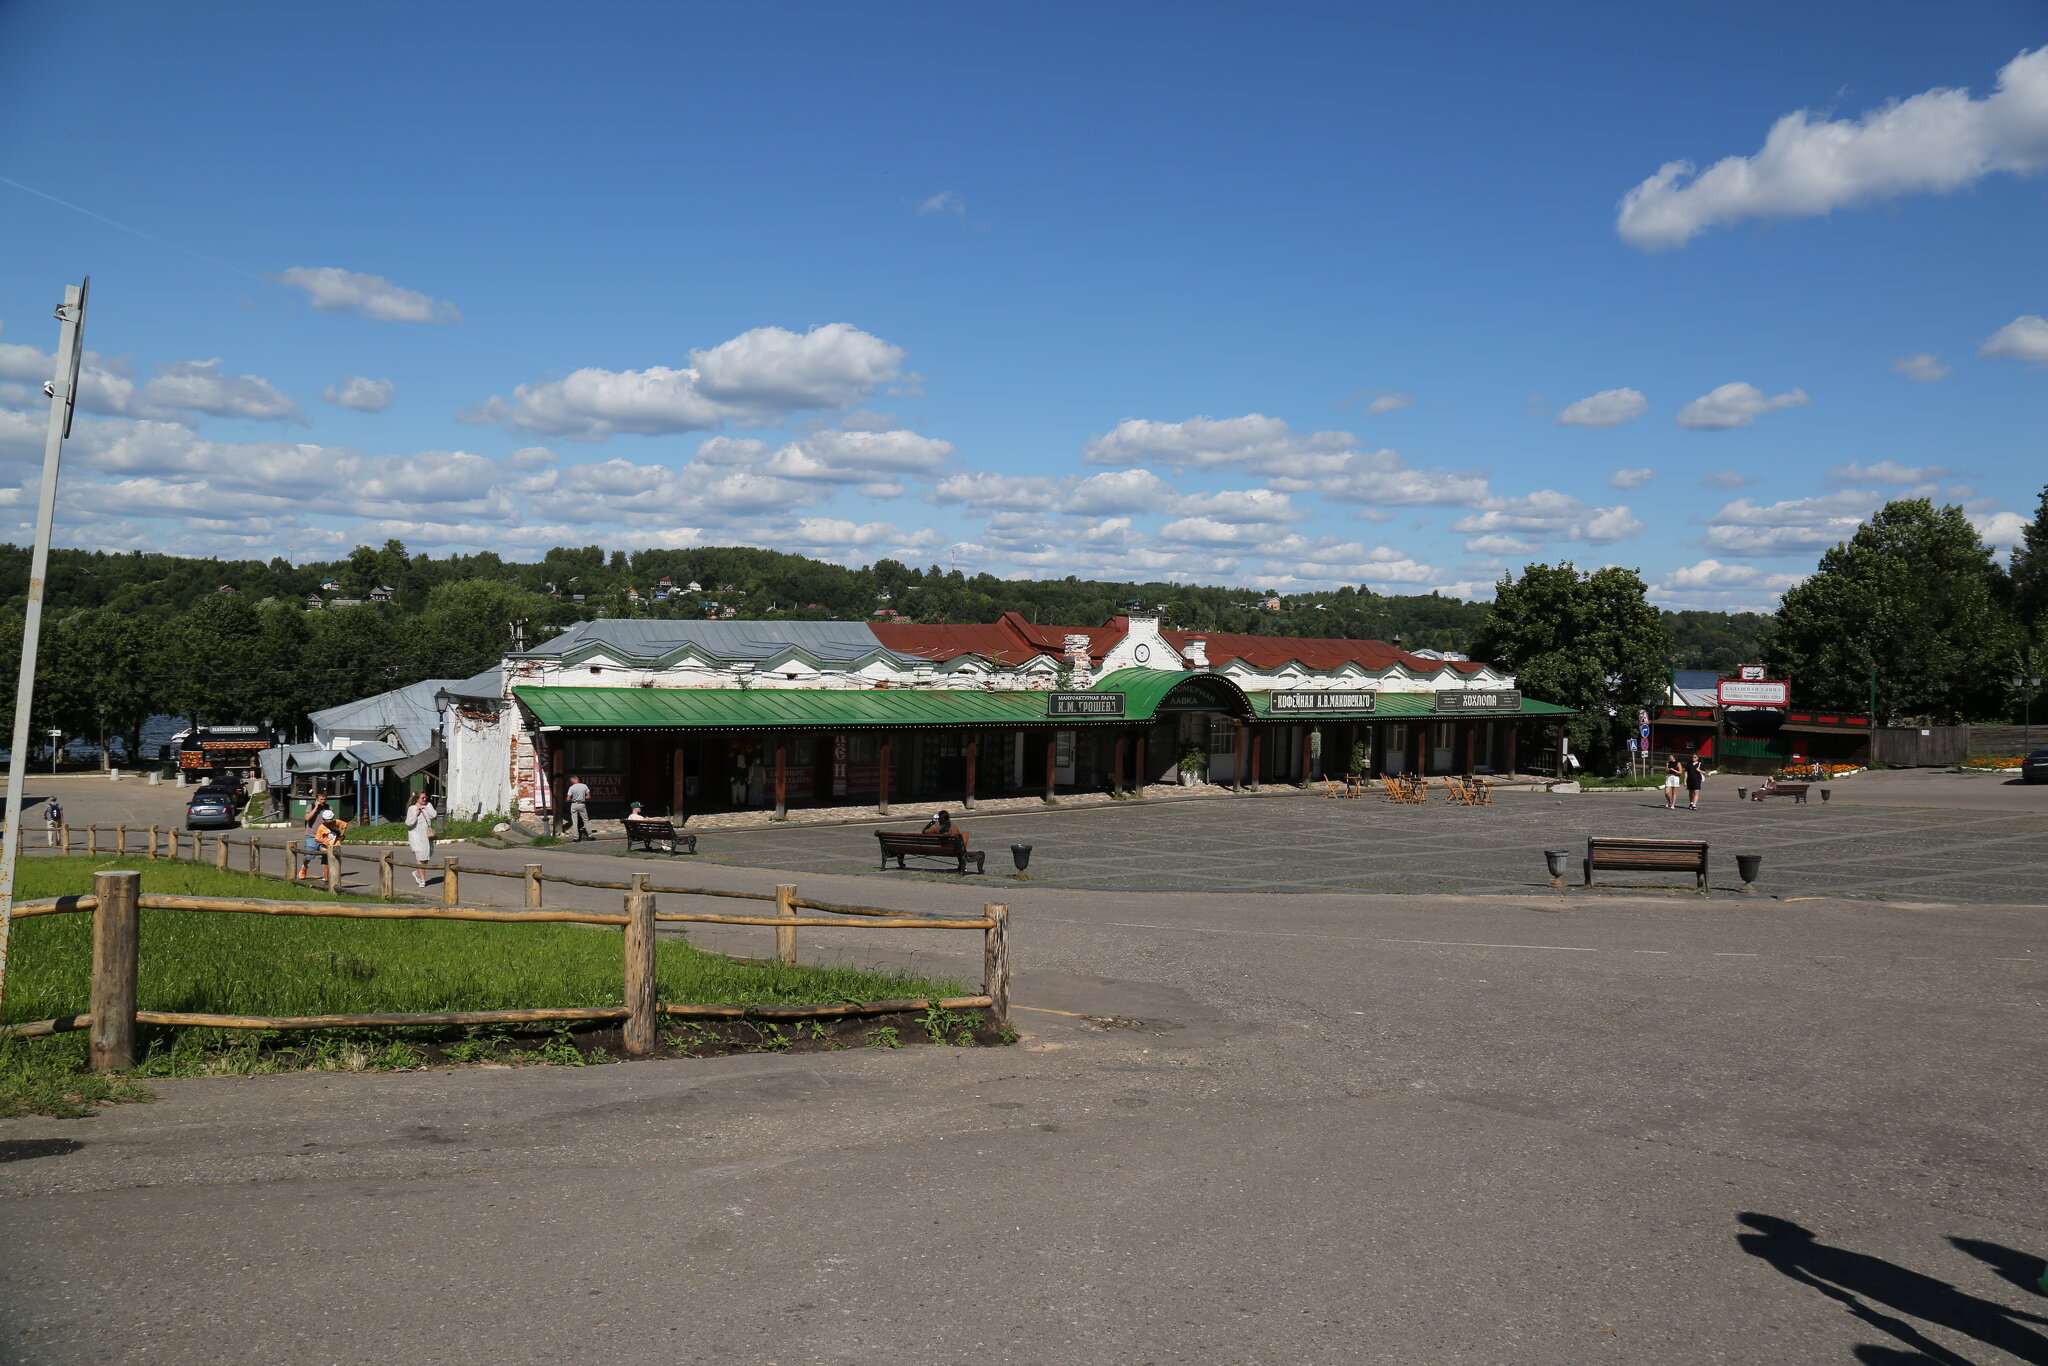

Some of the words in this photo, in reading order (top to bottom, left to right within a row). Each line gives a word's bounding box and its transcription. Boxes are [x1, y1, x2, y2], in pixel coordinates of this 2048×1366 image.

[1170, 697, 1198, 705] ЛАВКА
[1277, 693, 1314, 708] КОФЕЙНАЯ
[1462, 694, 1497, 707] ХОХЛОМА
